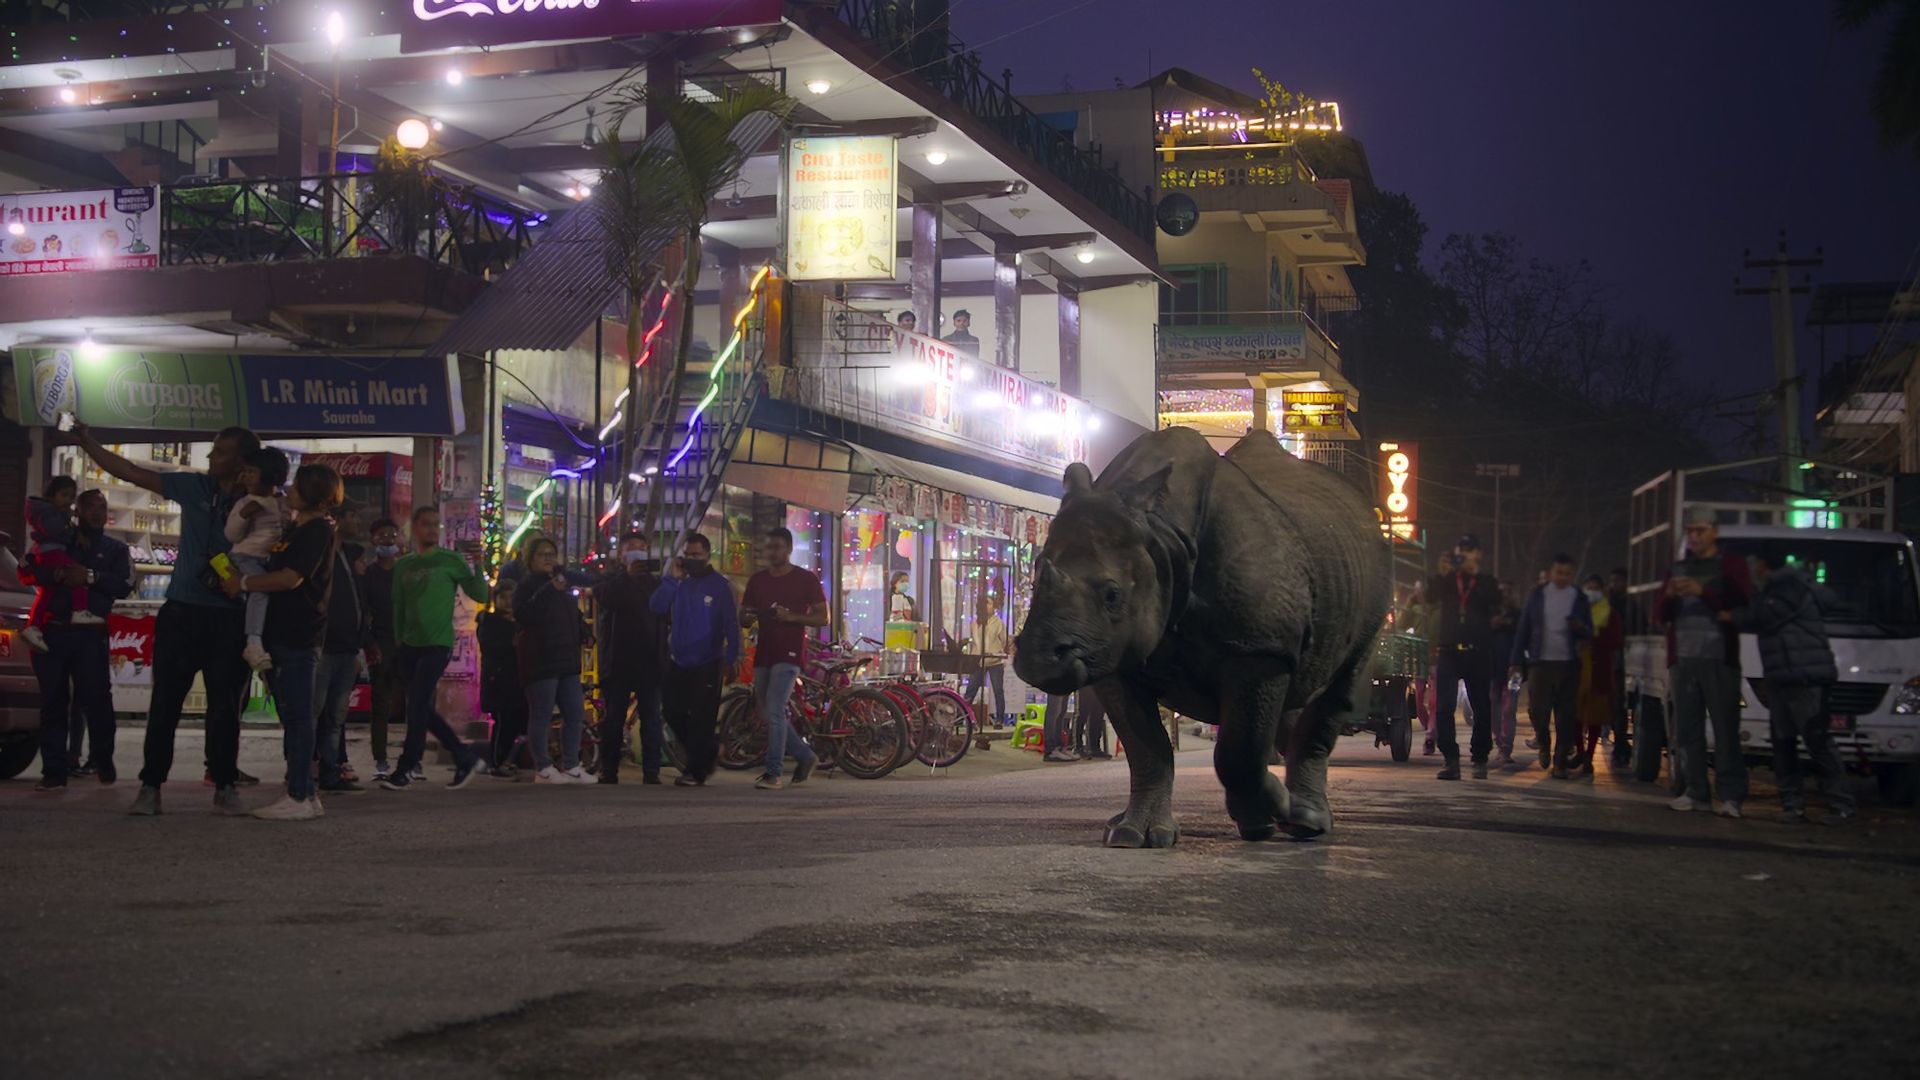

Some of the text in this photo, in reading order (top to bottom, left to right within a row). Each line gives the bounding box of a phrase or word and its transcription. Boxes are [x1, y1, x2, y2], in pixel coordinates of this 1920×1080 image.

[802, 151, 884, 167] City Taste
[796, 167, 889, 182] Restaurant
[909, 337, 955, 382] TASTE
[41, 366, 69, 418] TUBORG
[123, 381, 223, 409] TUBORG
[261, 379, 428, 406] I.R Mini Mart
[322, 410, 376, 424] Sauraha
[1387, 452, 1409, 513] OYO
